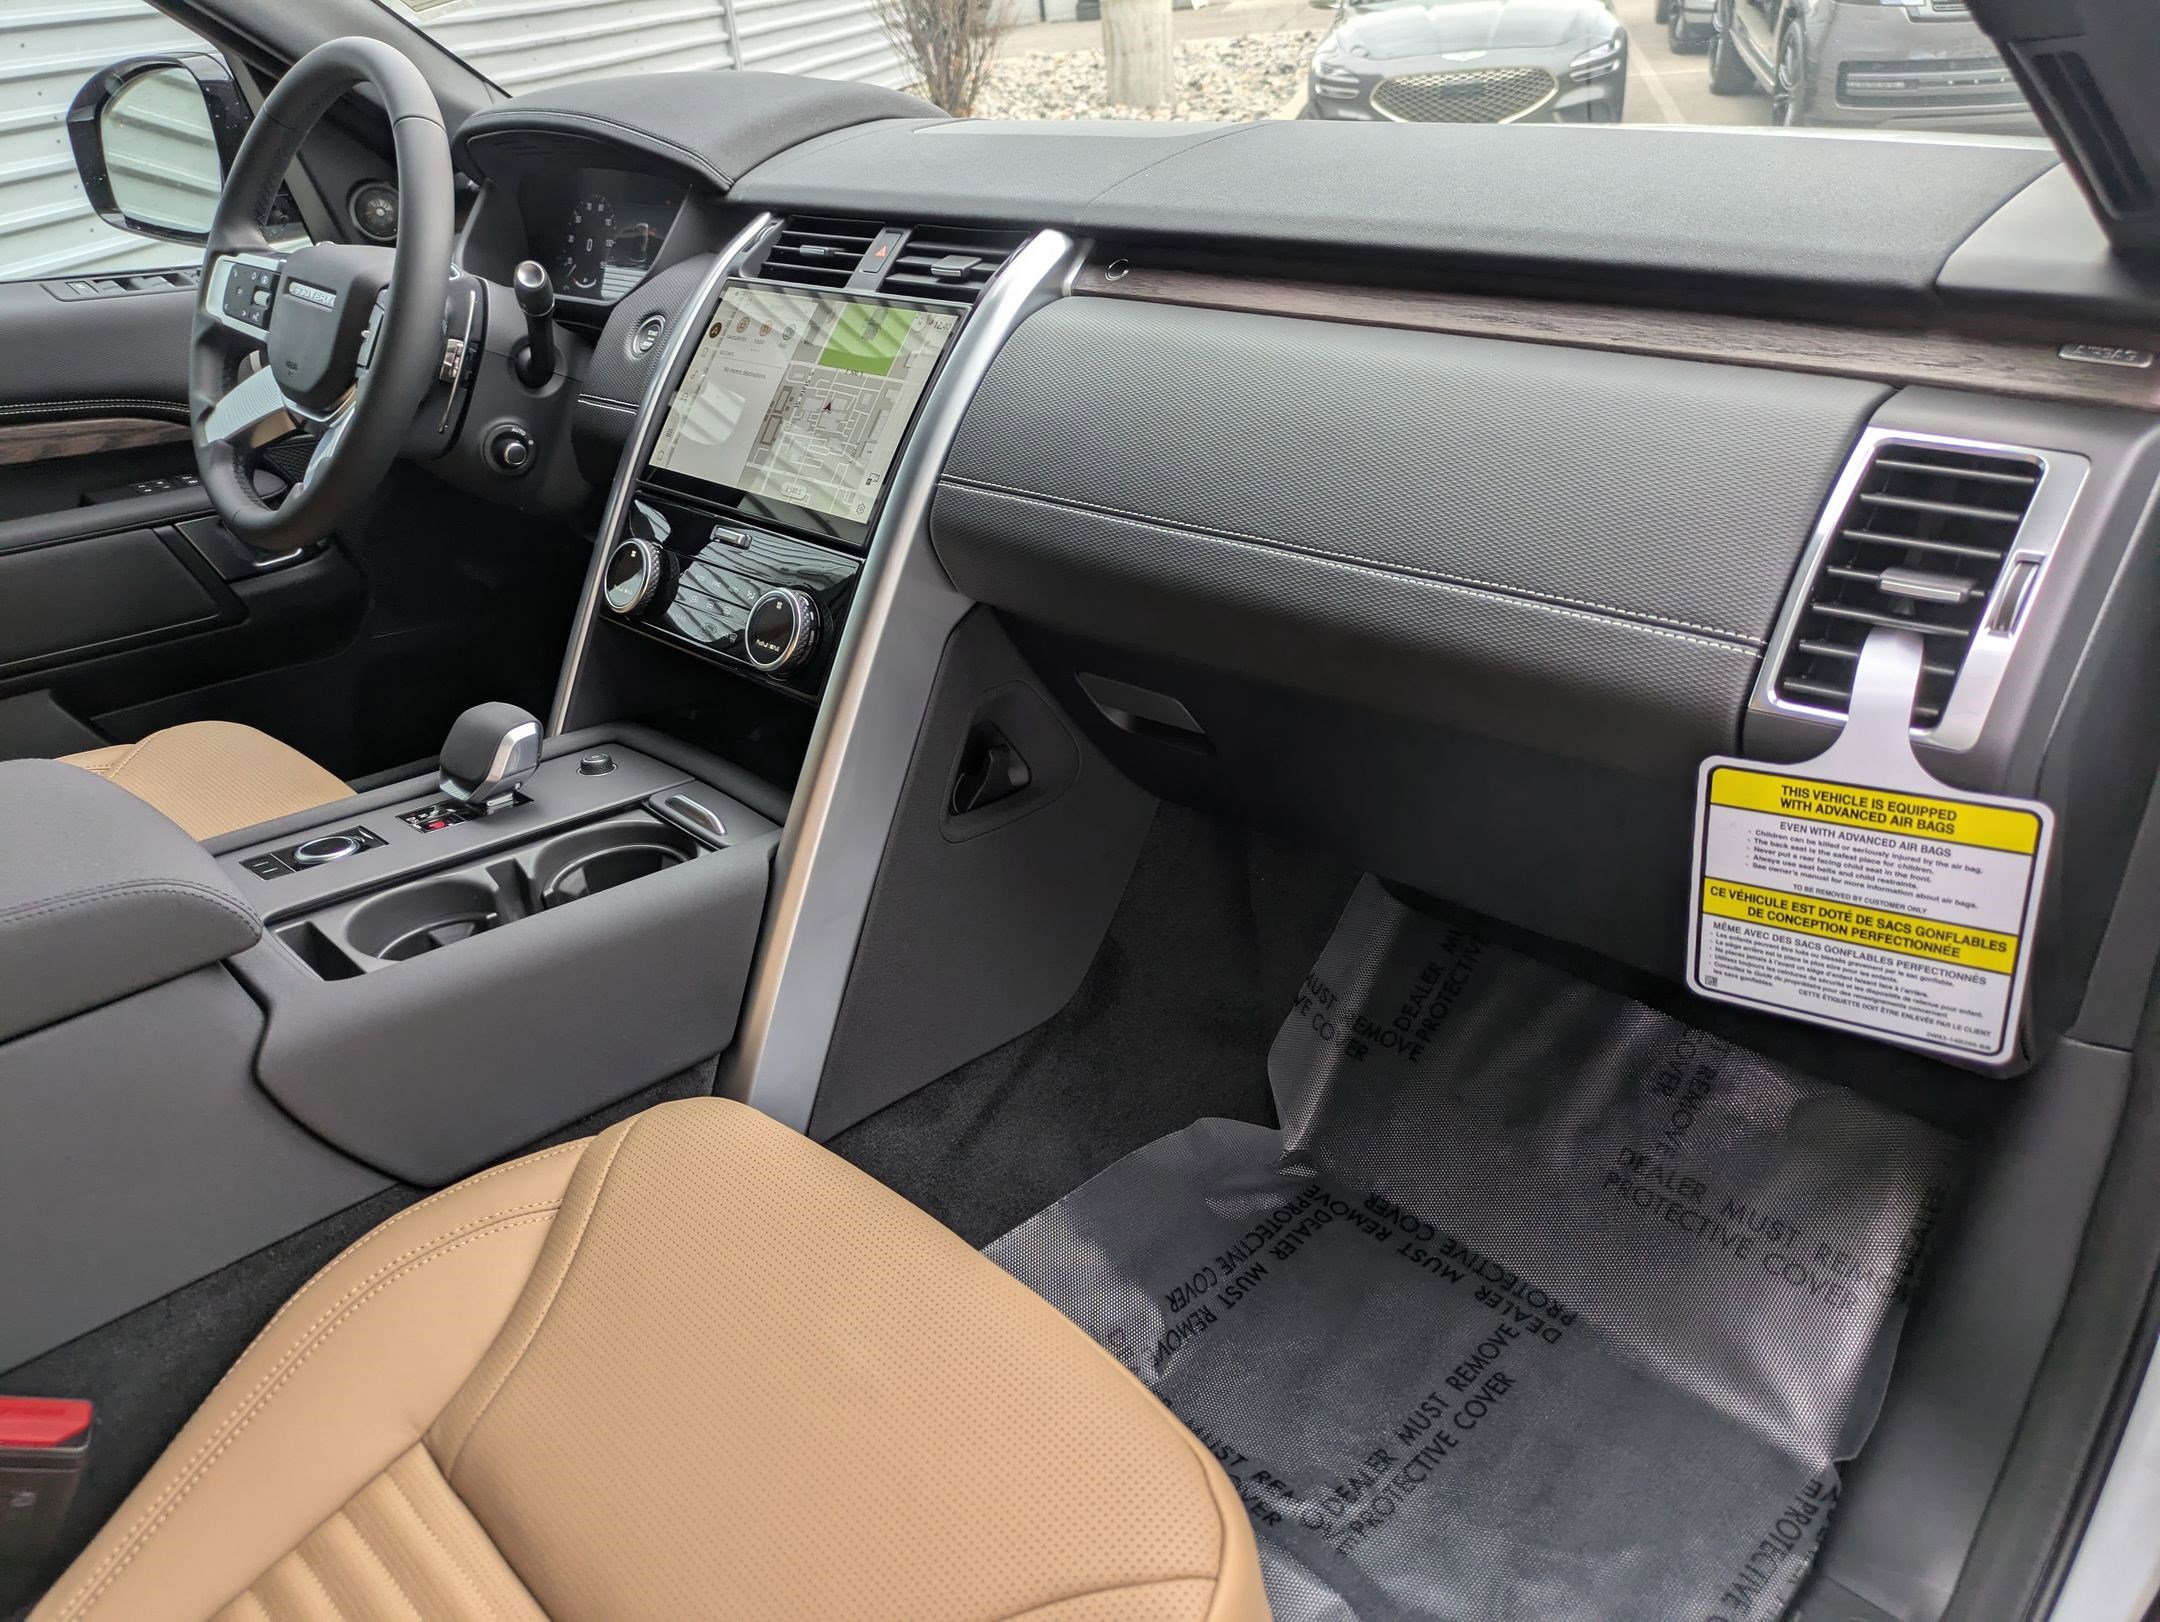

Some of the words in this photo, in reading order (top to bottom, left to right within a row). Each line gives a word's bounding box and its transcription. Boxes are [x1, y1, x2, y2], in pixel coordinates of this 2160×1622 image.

[511, 426, 526, 437] AUTO
[1780, 797, 1811, 812] WITH
[1814, 803, 1887, 824] ADVANCED
[1890, 814, 1913, 828] AIR
[1916, 818, 1955, 834] BAGS
[1781, 785, 1811, 799] THIS
[1813, 790, 1868, 808] VEHICLE
[1870, 799, 1884, 810] IS
[1887, 801, 1957, 821] EQUIPPED
[1755, 829, 1787, 840] Children
[1789, 835, 1804, 843] can
[1817, 840, 1839, 849] killed
[1852, 846, 1889, 858] seriously
[1891, 852, 1920, 863] injured
[1935, 860, 1949, 868] the
[1950, 862, 1962, 870] air
[1964, 864, 1983, 874] bag.
[1769, 841, 1788, 849] back
[1790, 844, 1806, 852] seat
[1832, 851, 1856, 861] safest
[1859, 856, 1880, 865] place
[1897, 862, 1934, 874] children.
[1779, 821, 1807, 833] EVEN
[1809, 826, 1835, 838] WITH
[1838, 830, 1896, 848] ADVANCED
[1899, 840, 1917, 852] AIR
[1920, 844, 1951, 857] BAGS
[1710, 886, 1727, 898] CE
[1728, 887, 1789, 910] VÉHICULE
[1791, 902, 1815, 915] EST
[1817, 904, 1852, 922] DOTÉ
[1856, 914, 1873, 927] DE
[1876, 918, 1912, 934] SACS
[1915, 926, 2007, 953] GONFLABLES
[1793, 883, 1802, 891] TO
[1804, 885, 1814, 893] BE
[1815, 888, 1850, 900] REMOVED
[1852, 894, 1862, 902] BY
[1864, 897, 1905, 910] CUSTOMER
[1906, 905, 1926, 914] ONLY
[1713, 919, 1741, 934] MÊME
[1743, 927, 1769, 940] AVEC
[1772, 933, 1791, 944] DES
[1794, 938, 1821, 951] SACS
[1824, 944, 1893, 966] GONFLABLES
[1896, 957, 1987, 985] PERFECTIONNÉS
[1747, 906, 1764, 918] DE
[1767, 910, 1847, 935] CONCEPTION
[1850, 924, 1960, 958] PERFECTIONNÉE
[1392, 961, 1446, 1033] DEALER
[1303, 1184, 1393, 1243] REMOVE
[1364, 1192, 1436, 1242] COVER
[1602, 1171, 1754, 1260] PROTECTIVE
[1617, 1147, 1707, 1200] DEALER
[1719, 1199, 1800, 1247] MUST
[1215, 1196, 1311, 1276] PROTECTIVE
[1269, 1208, 1333, 1261] DEALER
[1165, 1266, 1218, 1314] COVER
[1217, 1262, 1269, 1310] MUST
[1397, 1242, 1465, 1285] MUST
[1439, 1237, 1578, 1328] PROTECTIVE
[1473, 1285, 1563, 1345] DEALER
[1321, 1446, 1399, 1517] DEALER
[1393, 1391, 1451, 1447] MUST
[1444, 1322, 1521, 1393] REMOVE
[1348, 1429, 1460, 1539] PROTECTIVE
[1452, 1371, 1517, 1432] COVER
[1720, 1496, 1819, 1613] PROTECTIVE
